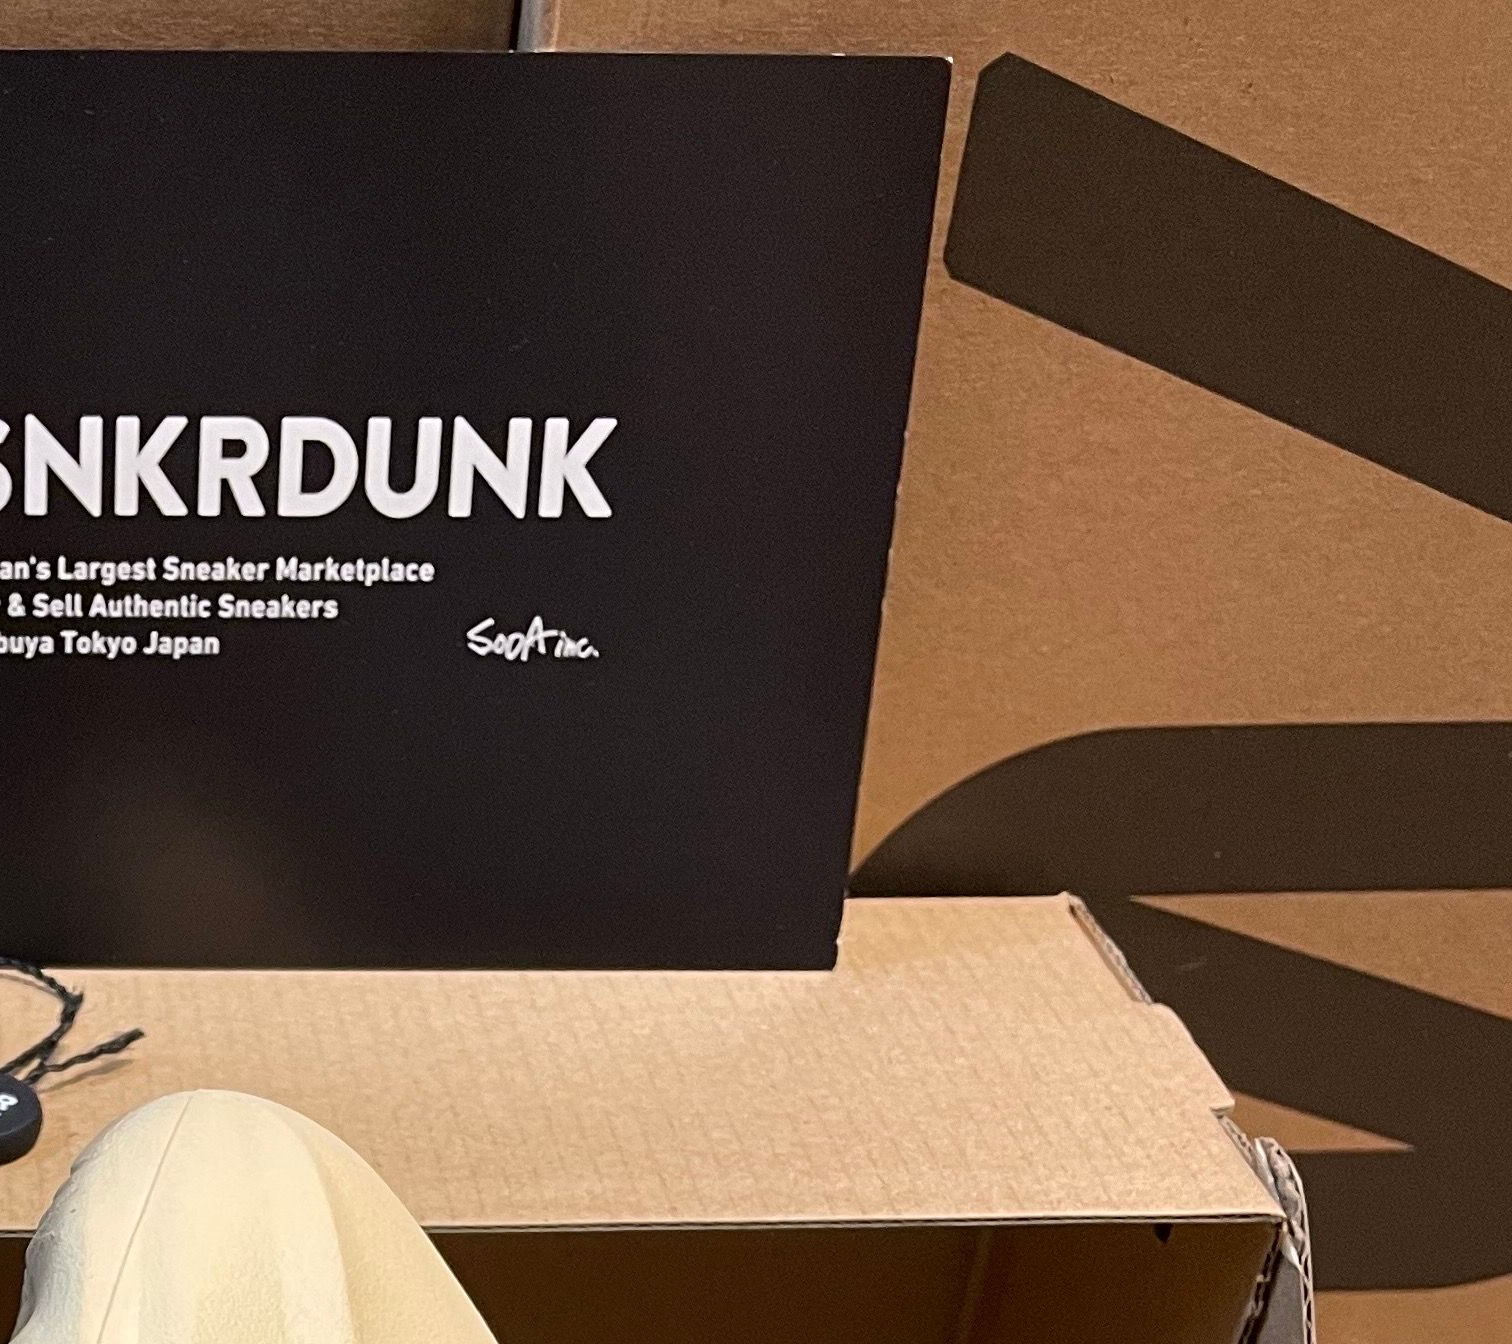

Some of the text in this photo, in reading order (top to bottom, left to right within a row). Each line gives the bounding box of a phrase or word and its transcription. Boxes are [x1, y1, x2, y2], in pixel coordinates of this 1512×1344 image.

[57, 555, 157, 587] Largest
[162, 555, 271, 583] Sneaker
[275, 556, 436, 588] Marketplace
[7, 592, 27, 618] &
[32, 592, 84, 618] Sell
[88, 593, 212, 619] Authentic
[217, 593, 339, 619] Sneakers
[59, 629, 138, 660] Tokyo
[143, 630, 220, 660] Japan
